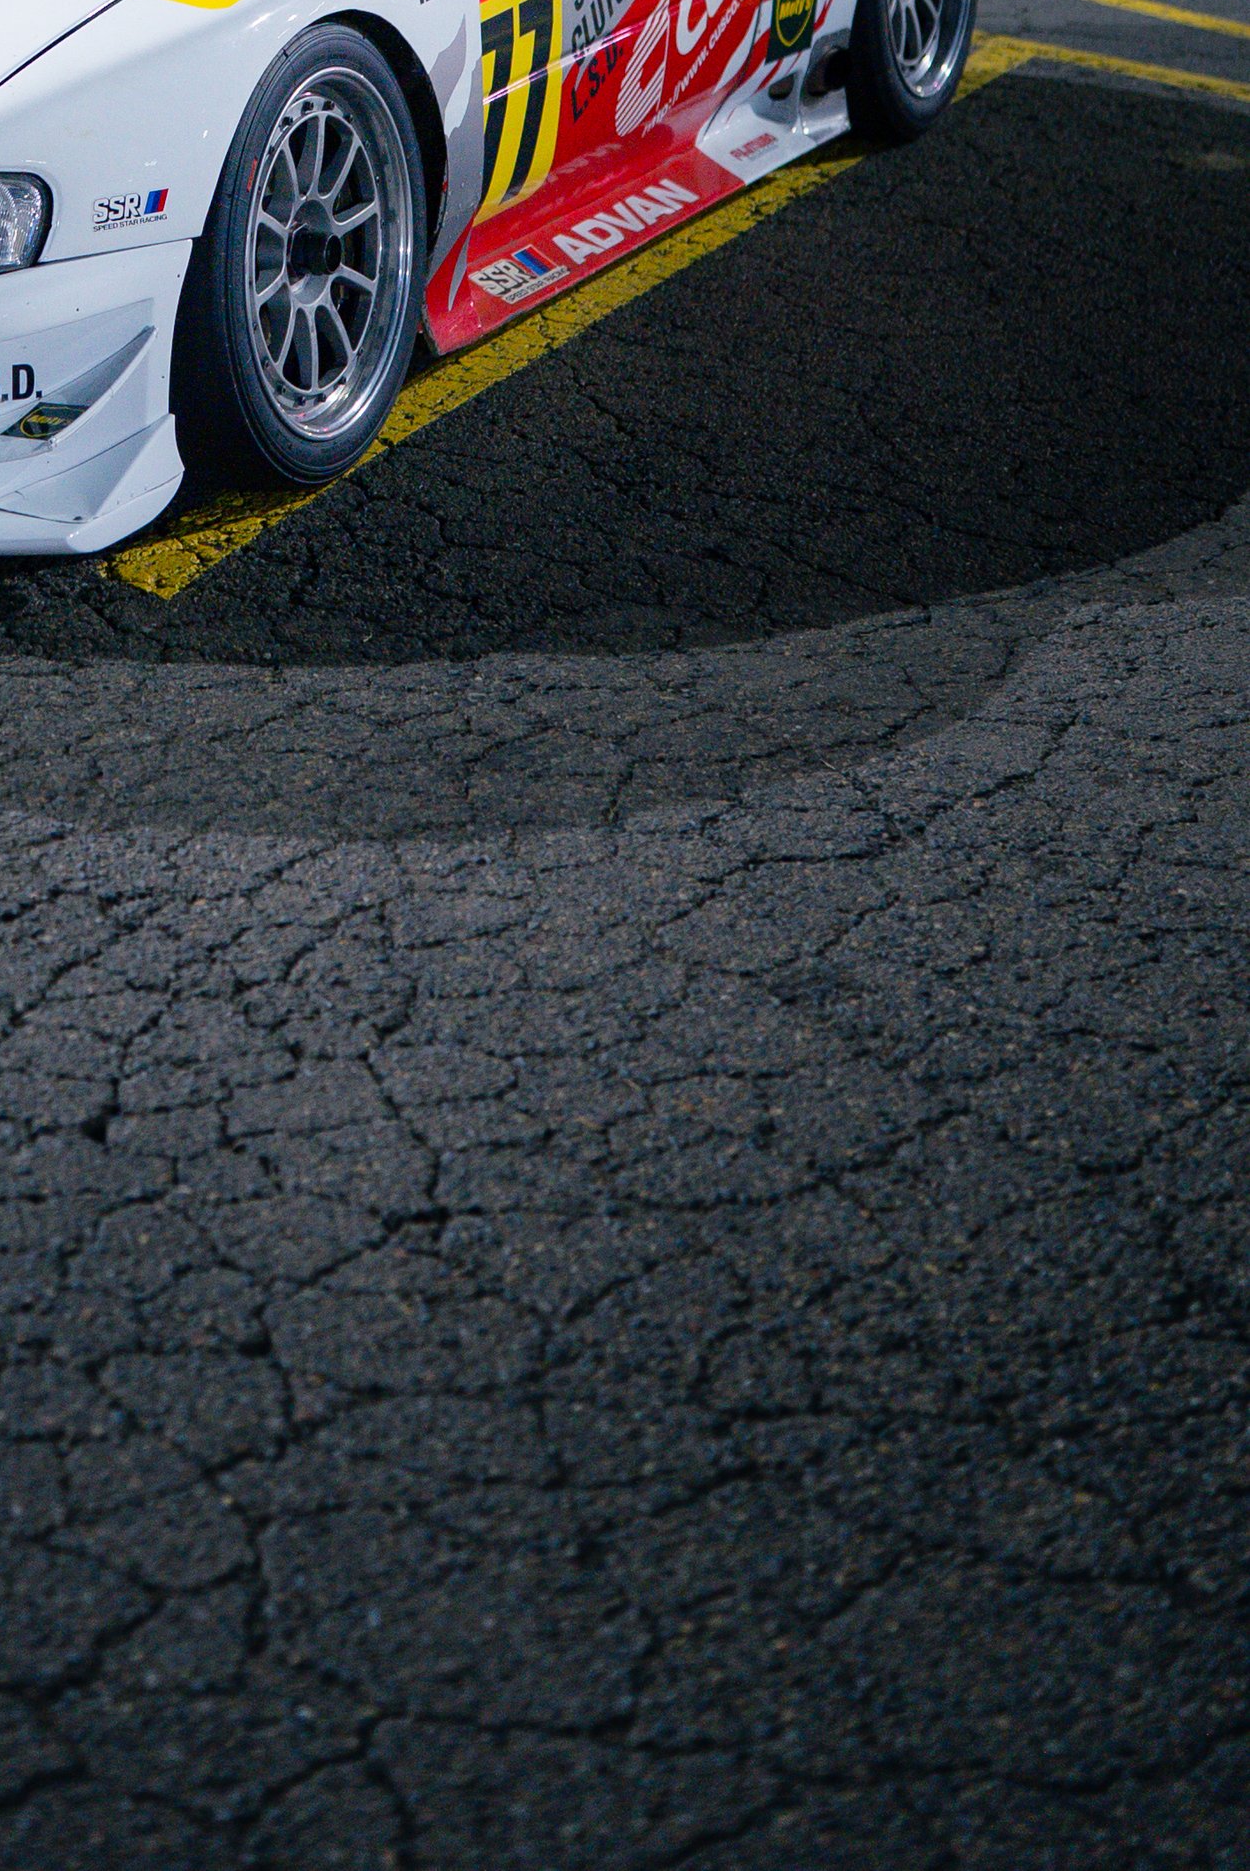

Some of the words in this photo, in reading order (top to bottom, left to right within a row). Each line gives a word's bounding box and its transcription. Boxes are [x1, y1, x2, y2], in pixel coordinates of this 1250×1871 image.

[92, 193, 141, 224] SSR
[93, 222, 118, 233] SPEED
[119, 218, 139, 228] STAR
[139, 213, 168, 225] RACING
[552, 178, 700, 265] ADVAN
[469, 259, 538, 297] SSR
